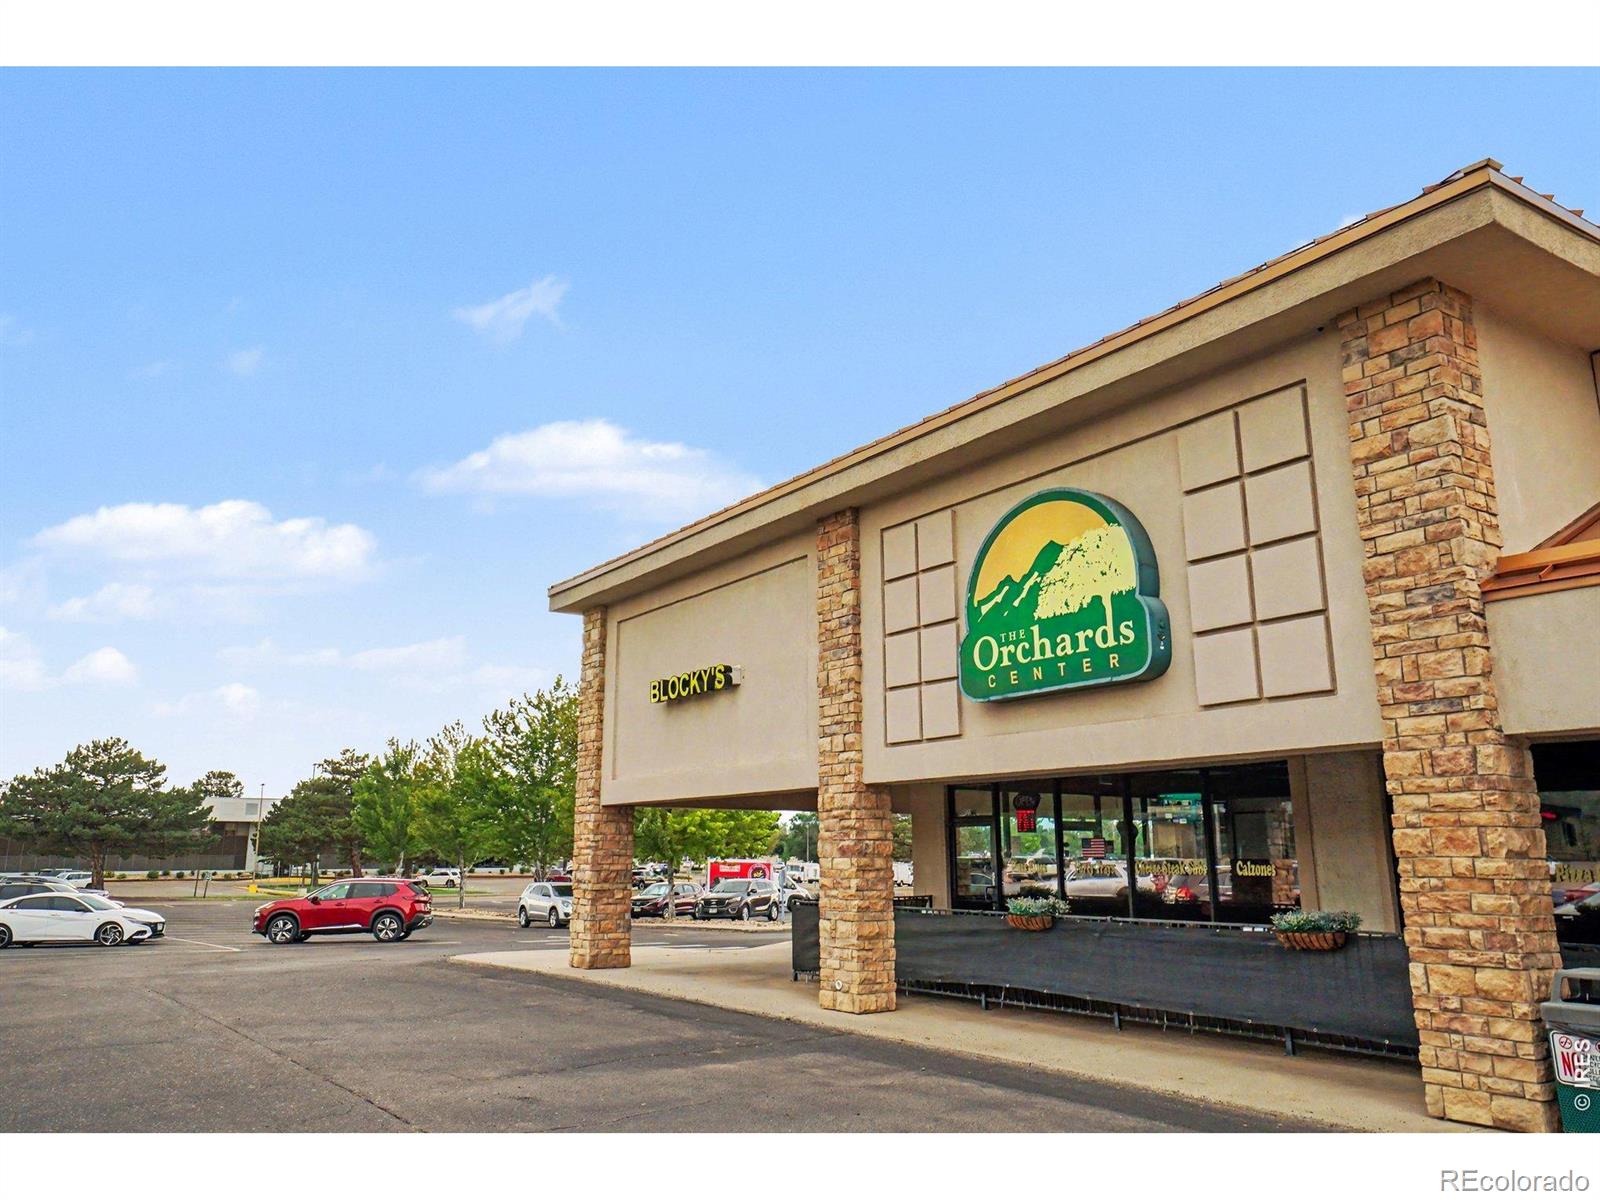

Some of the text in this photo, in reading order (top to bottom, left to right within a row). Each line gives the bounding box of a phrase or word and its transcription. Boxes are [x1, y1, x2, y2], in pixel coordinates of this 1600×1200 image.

[973, 620, 1136, 671] Orchards
[1000, 629, 1027, 643] THE
[650, 664, 726, 703] BLOCKY'S
[987, 653, 1120, 688] CENTER
[1236, 860, 1276, 876] Calzones
